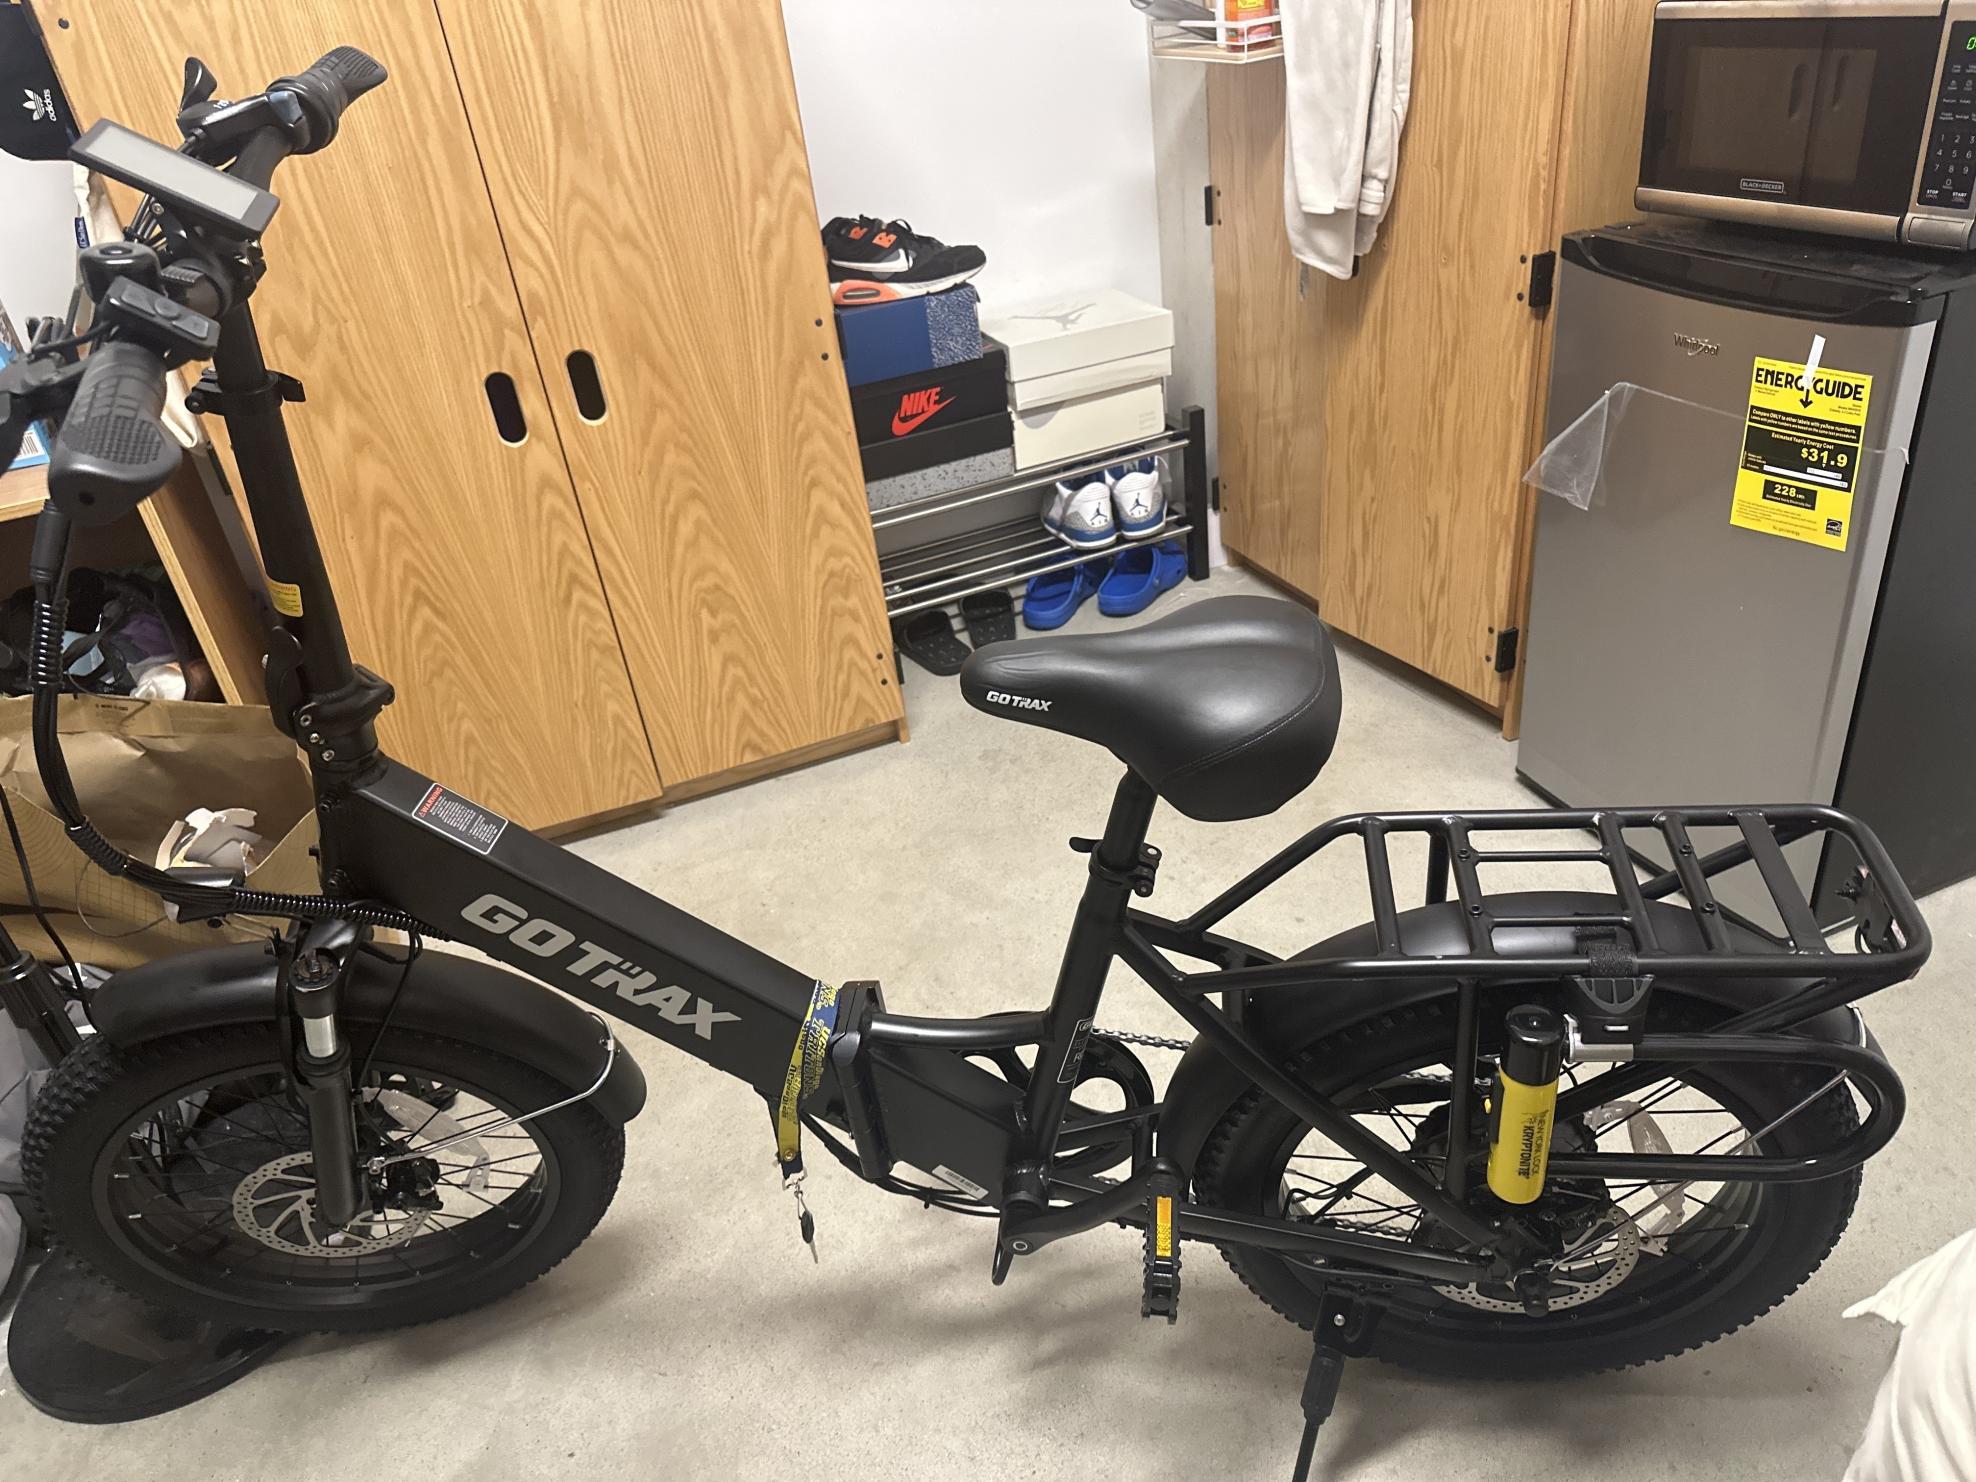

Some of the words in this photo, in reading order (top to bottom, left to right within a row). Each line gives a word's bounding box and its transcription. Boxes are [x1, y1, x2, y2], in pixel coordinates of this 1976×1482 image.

[43, 88, 57, 122] adidas
[1954, 135, 1960, 143] 2
[1952, 150, 1957, 158] 5
[1966, 151, 1972, 159] 6
[1948, 165, 1954, 173] 8
[1963, 166, 1969, 174] 9
[1945, 178, 1952, 186] 0
[900, 386, 941, 418] NIKE
[1752, 409, 1770, 418] Compare
[1770, 412, 1781, 420] ONLY
[1797, 418, 1811, 426] labels
[1820, 422, 1834, 431] yellow
[1771, 432, 1793, 442] Estimated
[1793, 436, 1806, 445] Yearly
[1806, 440, 1822, 449] Energy
[1823, 442, 1834, 450] Cost
[1801, 447, 1848, 468] $31.9
[1774, 484, 1797, 497] 228
[421, 786, 444, 814] WARNING
[1518, 1124, 1535, 1177] KRYPTONITE
